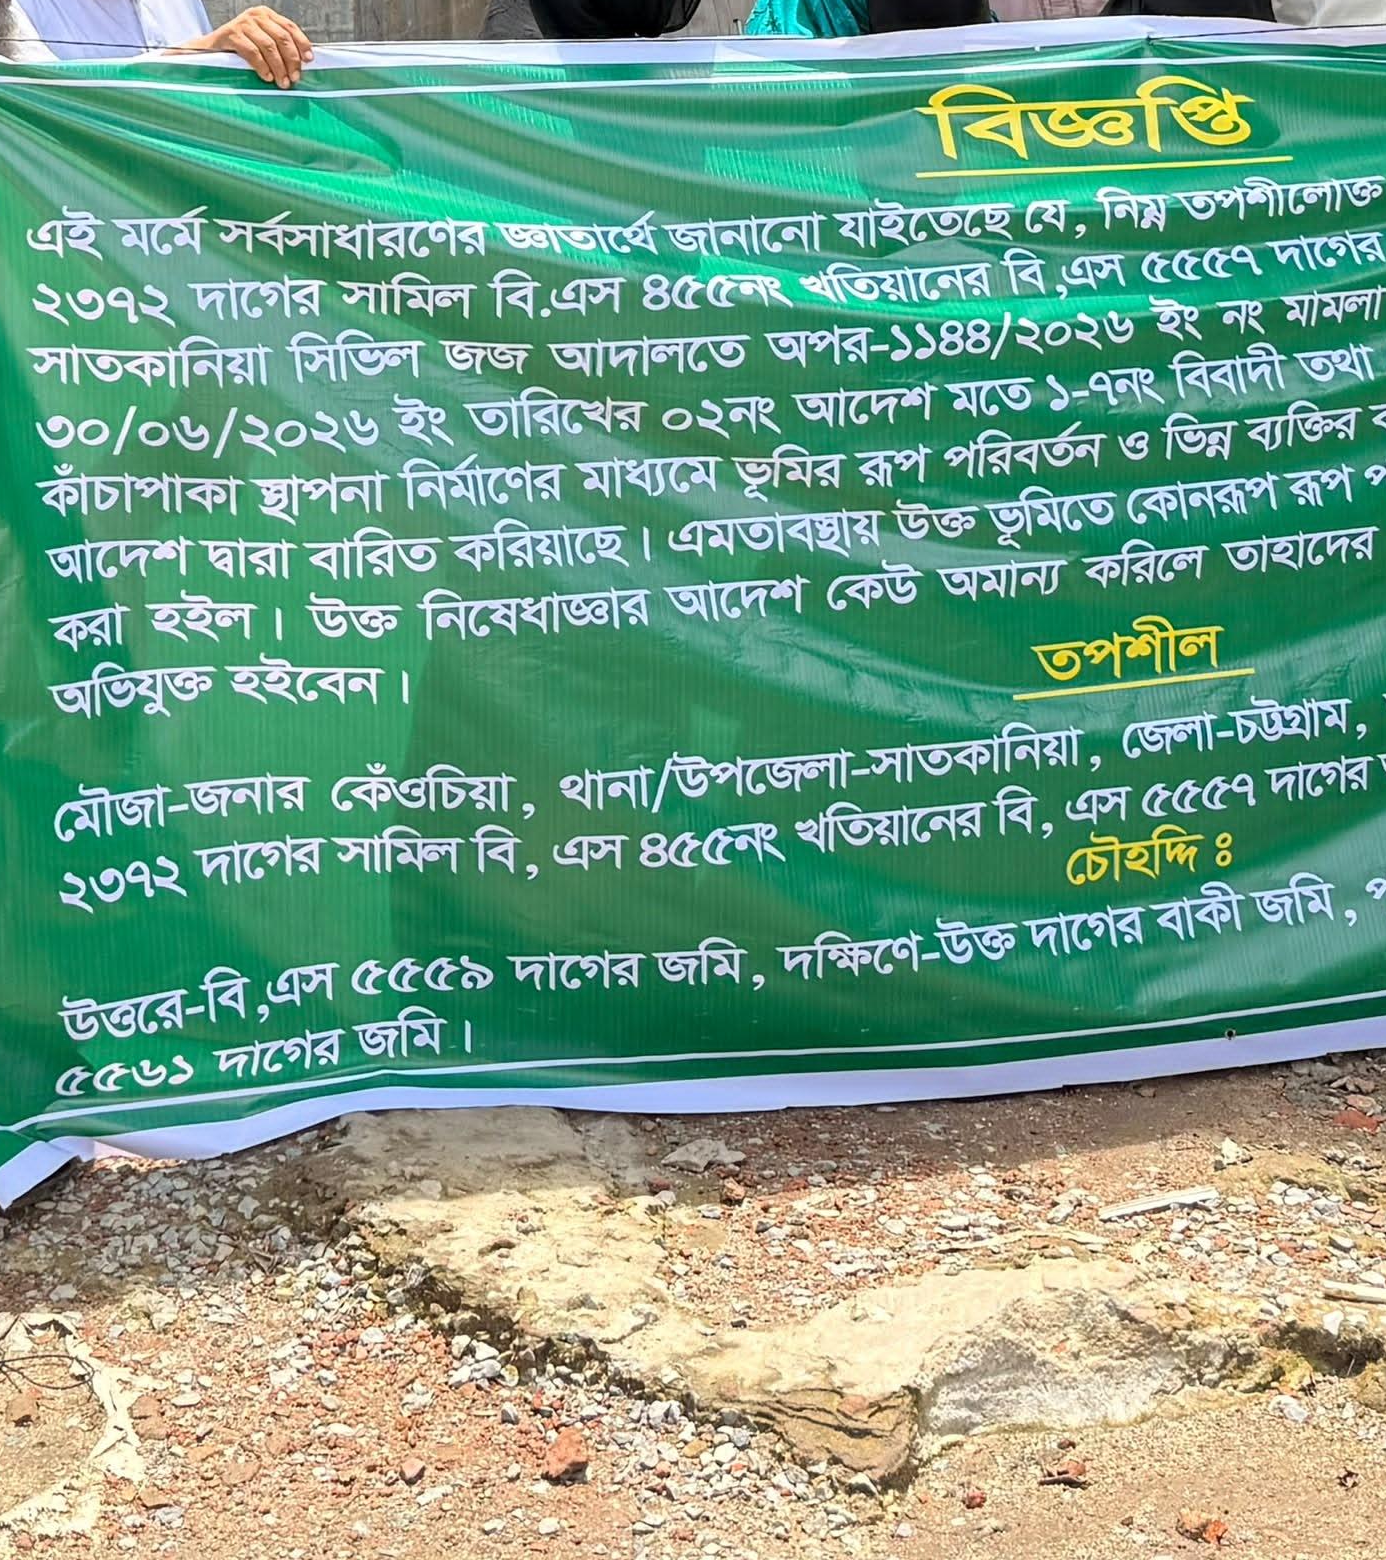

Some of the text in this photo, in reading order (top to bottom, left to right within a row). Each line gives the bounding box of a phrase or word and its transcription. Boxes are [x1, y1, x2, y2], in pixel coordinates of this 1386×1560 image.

[915, 76, 1255, 159] বিজ্ঞপ্তি
[27, 206, 105, 261] এই
[111, 206, 208, 256] মর্মে
[213, 211, 489, 260] সর্বসাধারণের
[494, 211, 658, 254] জ্ঞাতার্থে
[661, 211, 827, 256] জানানো
[833, 198, 1014, 248] যাইতেছে
[1094, 187, 1170, 231] নিম্ন
[1171, 176, 1385, 220] তপশীলোক্ত
[32, 283, 175, 328] ২৩৭২
[188, 275, 327, 320] দাগের
[337, 272, 477, 319] সামিল
[643, 274, 793, 310] ৪৫৫নং
[799, 263, 991, 302] খতিয়ানের
[1142, 245, 1262, 283] ৫৫৫৭
[1265, 230, 1385, 270] দাগের
[26, 336, 273, 388] সাতকানিয়া
[285, 329, 426, 383] সিভিল
[439, 341, 533, 374] জজ
[547, 335, 751, 377] আদালতে
[1149, 296, 1202, 340] ইং
[1216, 300, 1264, 334] নং
[391, 393, 454, 446] ইং
[463, 387, 648, 439] তারিখের
[662, 397, 781, 439] ০২নং
[792, 382, 938, 427] আদেশ
[944, 378, 1034, 417] মতে
[1168, 342, 1286, 399] বিবাদী
[1293, 344, 1374, 382] তথা
[36, 463, 245, 516] কাঁচাপাকা
[249, 470, 390, 525] স্থাপনা
[397, 454, 567, 510] নির্মাণের
[574, 456, 723, 498] মাধ্যমে
[731, 444, 846, 502] ভূমির
[855, 444, 932, 487] রূপ
[944, 422, 1107, 478] পরিবর্তন
[1118, 432, 1148, 460] ও
[1161, 413, 1238, 460] ভিন্ন
[1245, 401, 1362, 451] ব্যক্তির
[45, 536, 195, 582] আদেশ
[198, 538, 298, 579] দ্বারা
[303, 527, 443, 580] বারিত
[668, 508, 885, 558] এমতাবস্থায়
[891, 499, 979, 539] উক্ত
[984, 486, 1117, 549] ভূমিতে
[1127, 472, 1279, 524] কোনরূপ
[1283, 464, 1355, 506] রূপ
[49, 602, 131, 651] করা
[305, 592, 402, 639] উক্ত
[416, 587, 651, 640] নিষেধাজ্ঞার
[663, 575, 810, 621] আদেশ
[827, 559, 923, 610] কেউ
[936, 560, 1068, 600] অমান্য
[1082, 539, 1209, 588] করিলে
[1221, 527, 1379, 572] তাহাদের
[48, 662, 217, 718] অভিযুক্ত
[1031, 615, 1224, 681] তপশীল
[60, 856, 186, 913] ২৩৭২
[193, 835, 327, 885] দাগের
[331, 826, 465, 873] সামিল
[553, 835, 629, 870] এস
[640, 823, 785, 867] ৪৫৫নং
[795, 802, 987, 852] খতিয়ানের
[1066, 787, 1132, 824] এস
[1142, 774, 1255, 816] ৫৫৫৭
[1265, 756, 1373, 800] দাগের
[352, 956, 493, 994] ৫৫৫৯
[507, 951, 646, 990] দাগের
[1022, 906, 1145, 955] দাগের
[1149, 882, 1245, 939] বাকী
[56, 1055, 194, 1095] ৫৫৬১
[213, 1029, 345, 1077] দাগের
